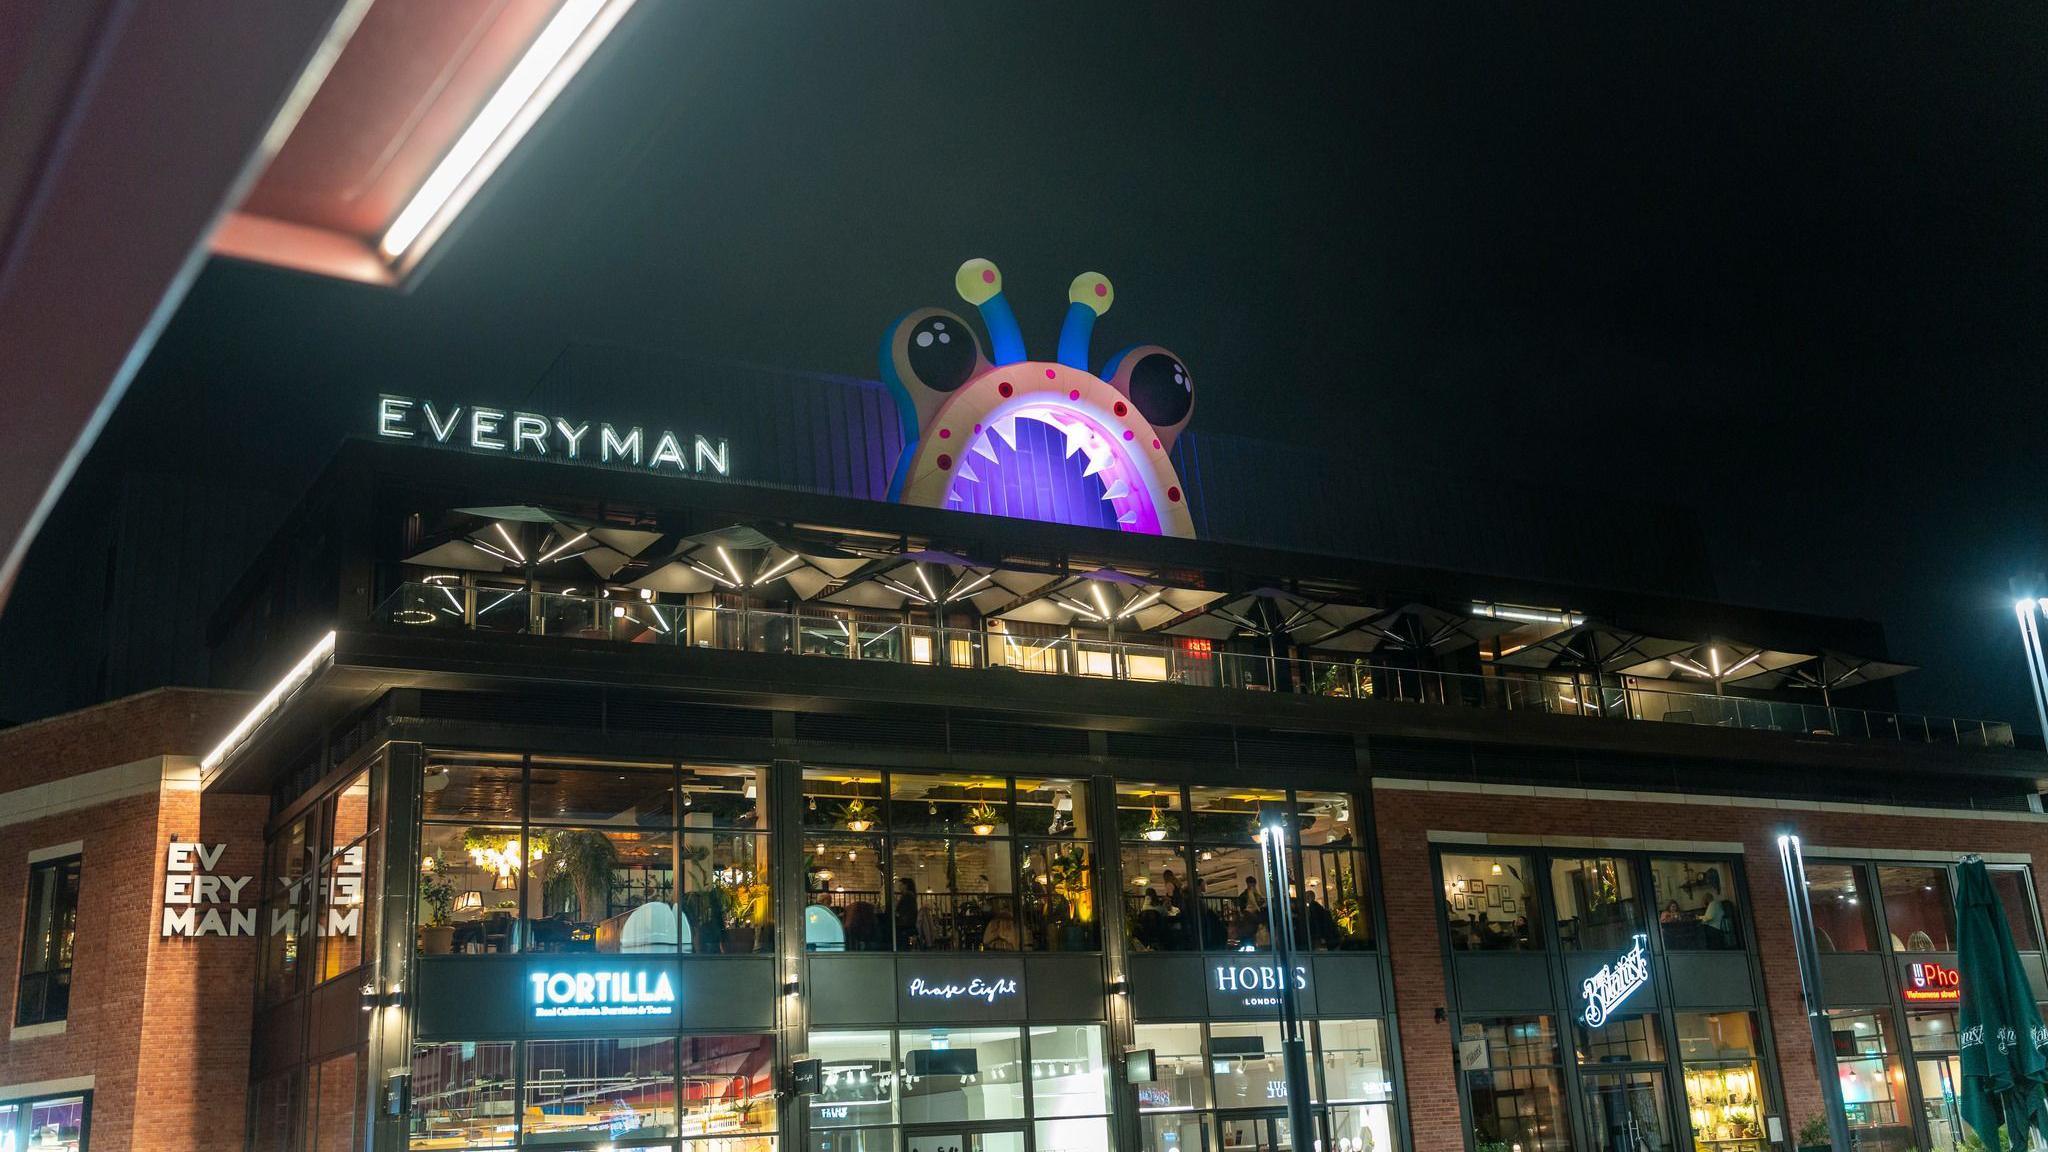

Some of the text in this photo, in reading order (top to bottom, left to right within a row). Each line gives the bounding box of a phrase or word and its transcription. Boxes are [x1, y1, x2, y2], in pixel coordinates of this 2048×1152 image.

[378, 393, 730, 477] EVERYMAN
[167, 842, 227, 872] EV
[165, 876, 254, 904] ERY
[162, 908, 256, 937] MAN
[530, 971, 675, 1004] TORTILLA
[1924, 964, 1959, 986] Pho
[910, 978, 1016, 1002] Phase Eight
